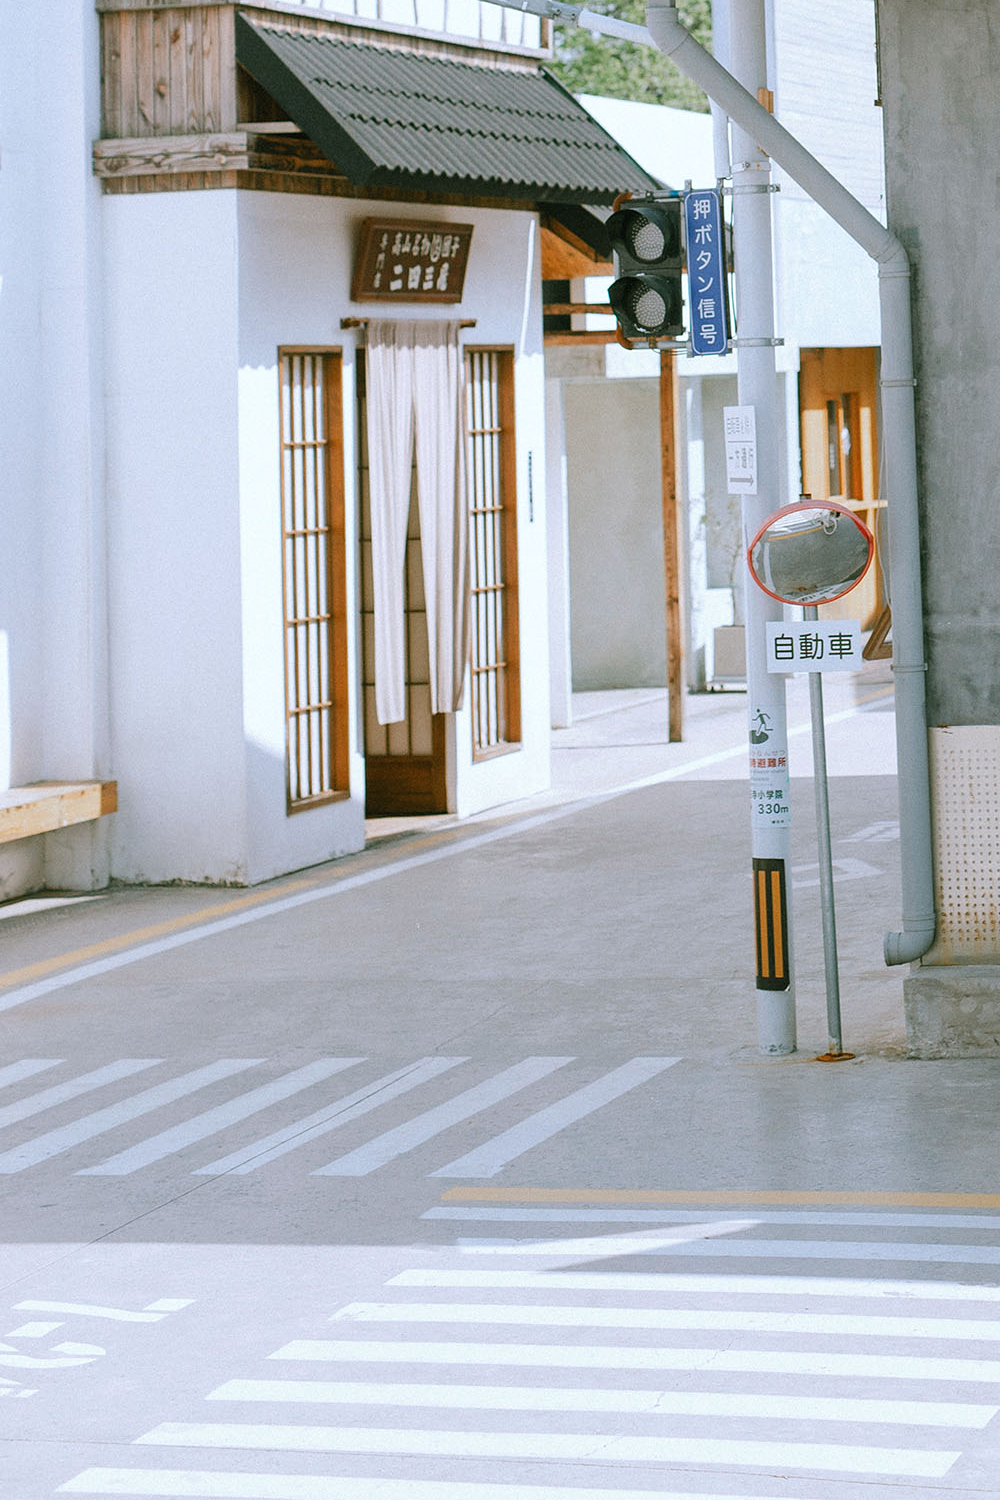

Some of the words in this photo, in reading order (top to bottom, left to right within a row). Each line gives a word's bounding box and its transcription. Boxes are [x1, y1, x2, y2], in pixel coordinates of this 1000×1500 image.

[692, 199, 718, 345] 押ボタン信号
[774, 632, 855, 661] 自動車
[758, 803, 789, 815] 330m
